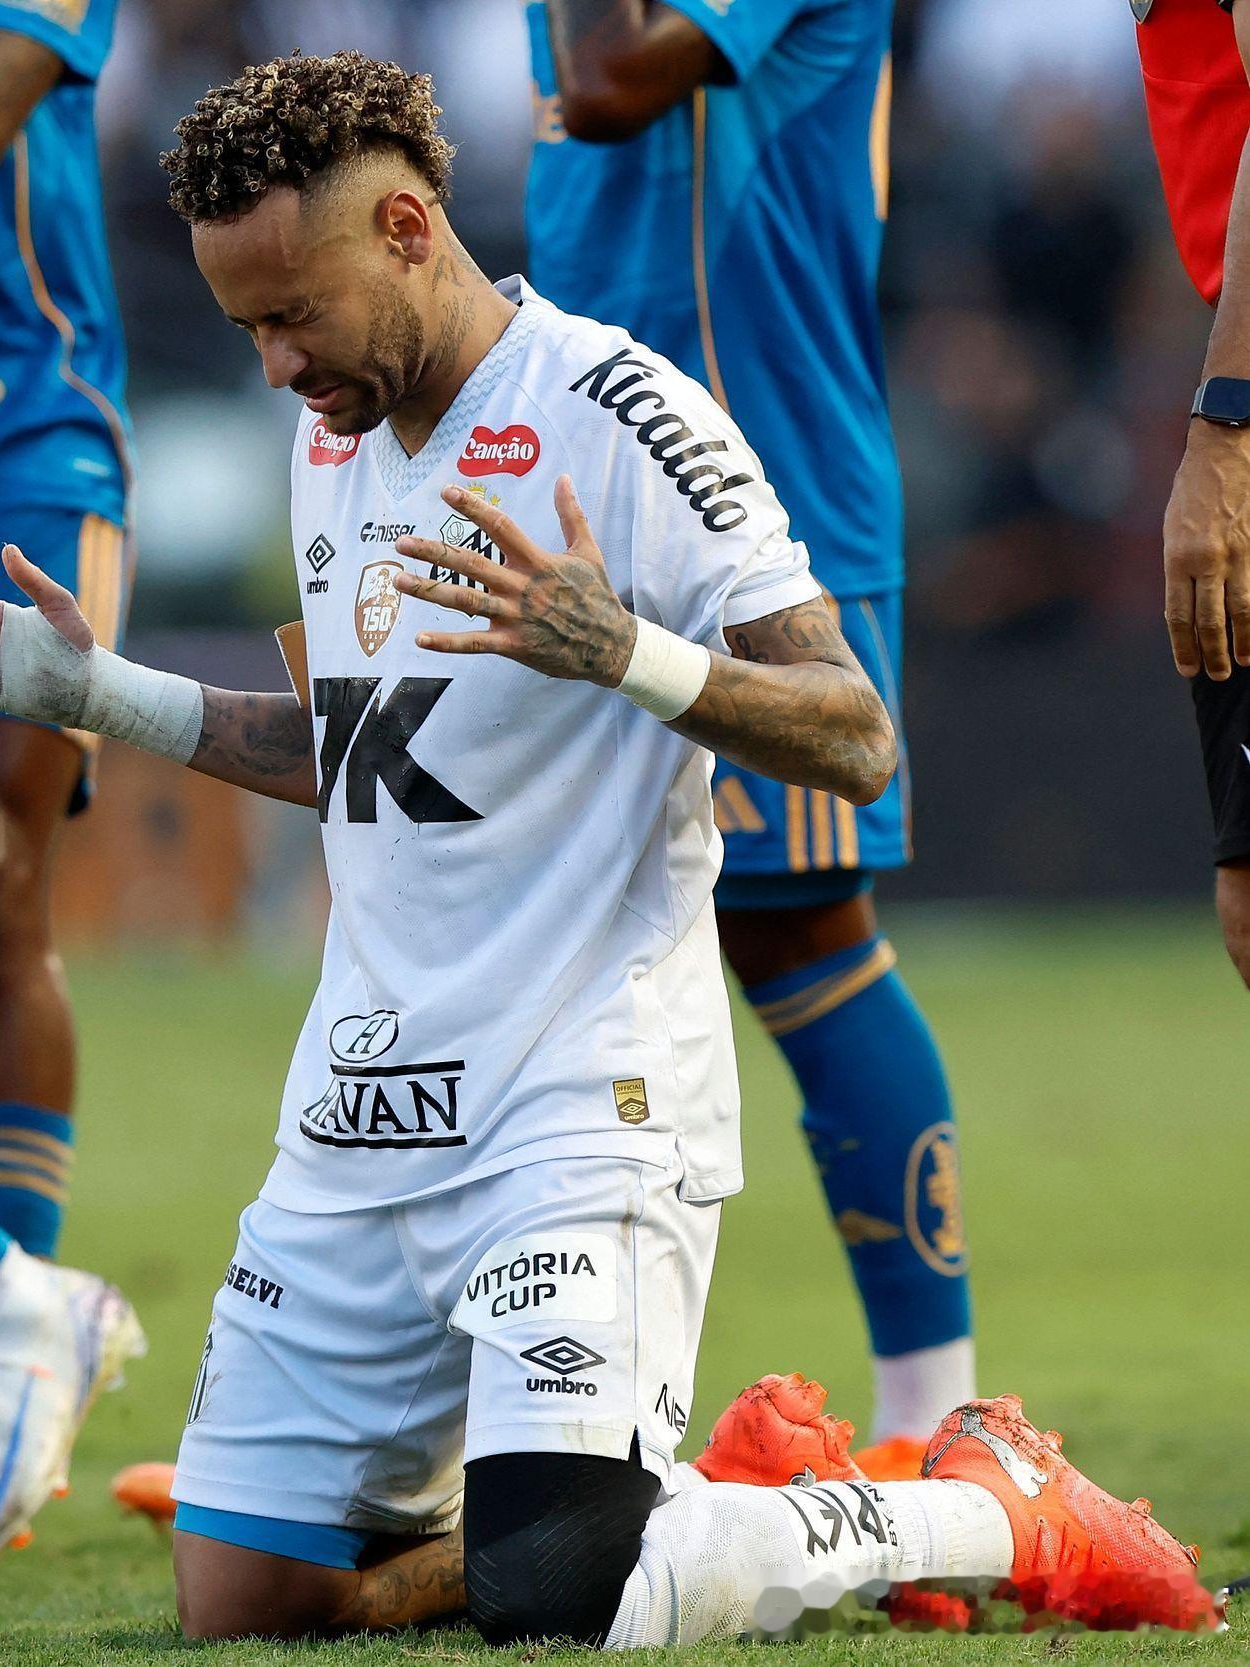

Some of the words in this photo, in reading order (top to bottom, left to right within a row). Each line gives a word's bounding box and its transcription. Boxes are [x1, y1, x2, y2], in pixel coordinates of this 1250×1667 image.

[461, 436, 534, 466] Canção
[568, 348, 754, 532] Kicaldo
[306, 577, 329, 594] umbro
[362, 606, 392, 631] 150
[313, 676, 486, 823] 7K
[345, 1017, 392, 1054] H
[466, 1252, 597, 1301] VITÓRIA
[491, 1283, 557, 1317] CUP
[526, 1377, 598, 1396] umbro
